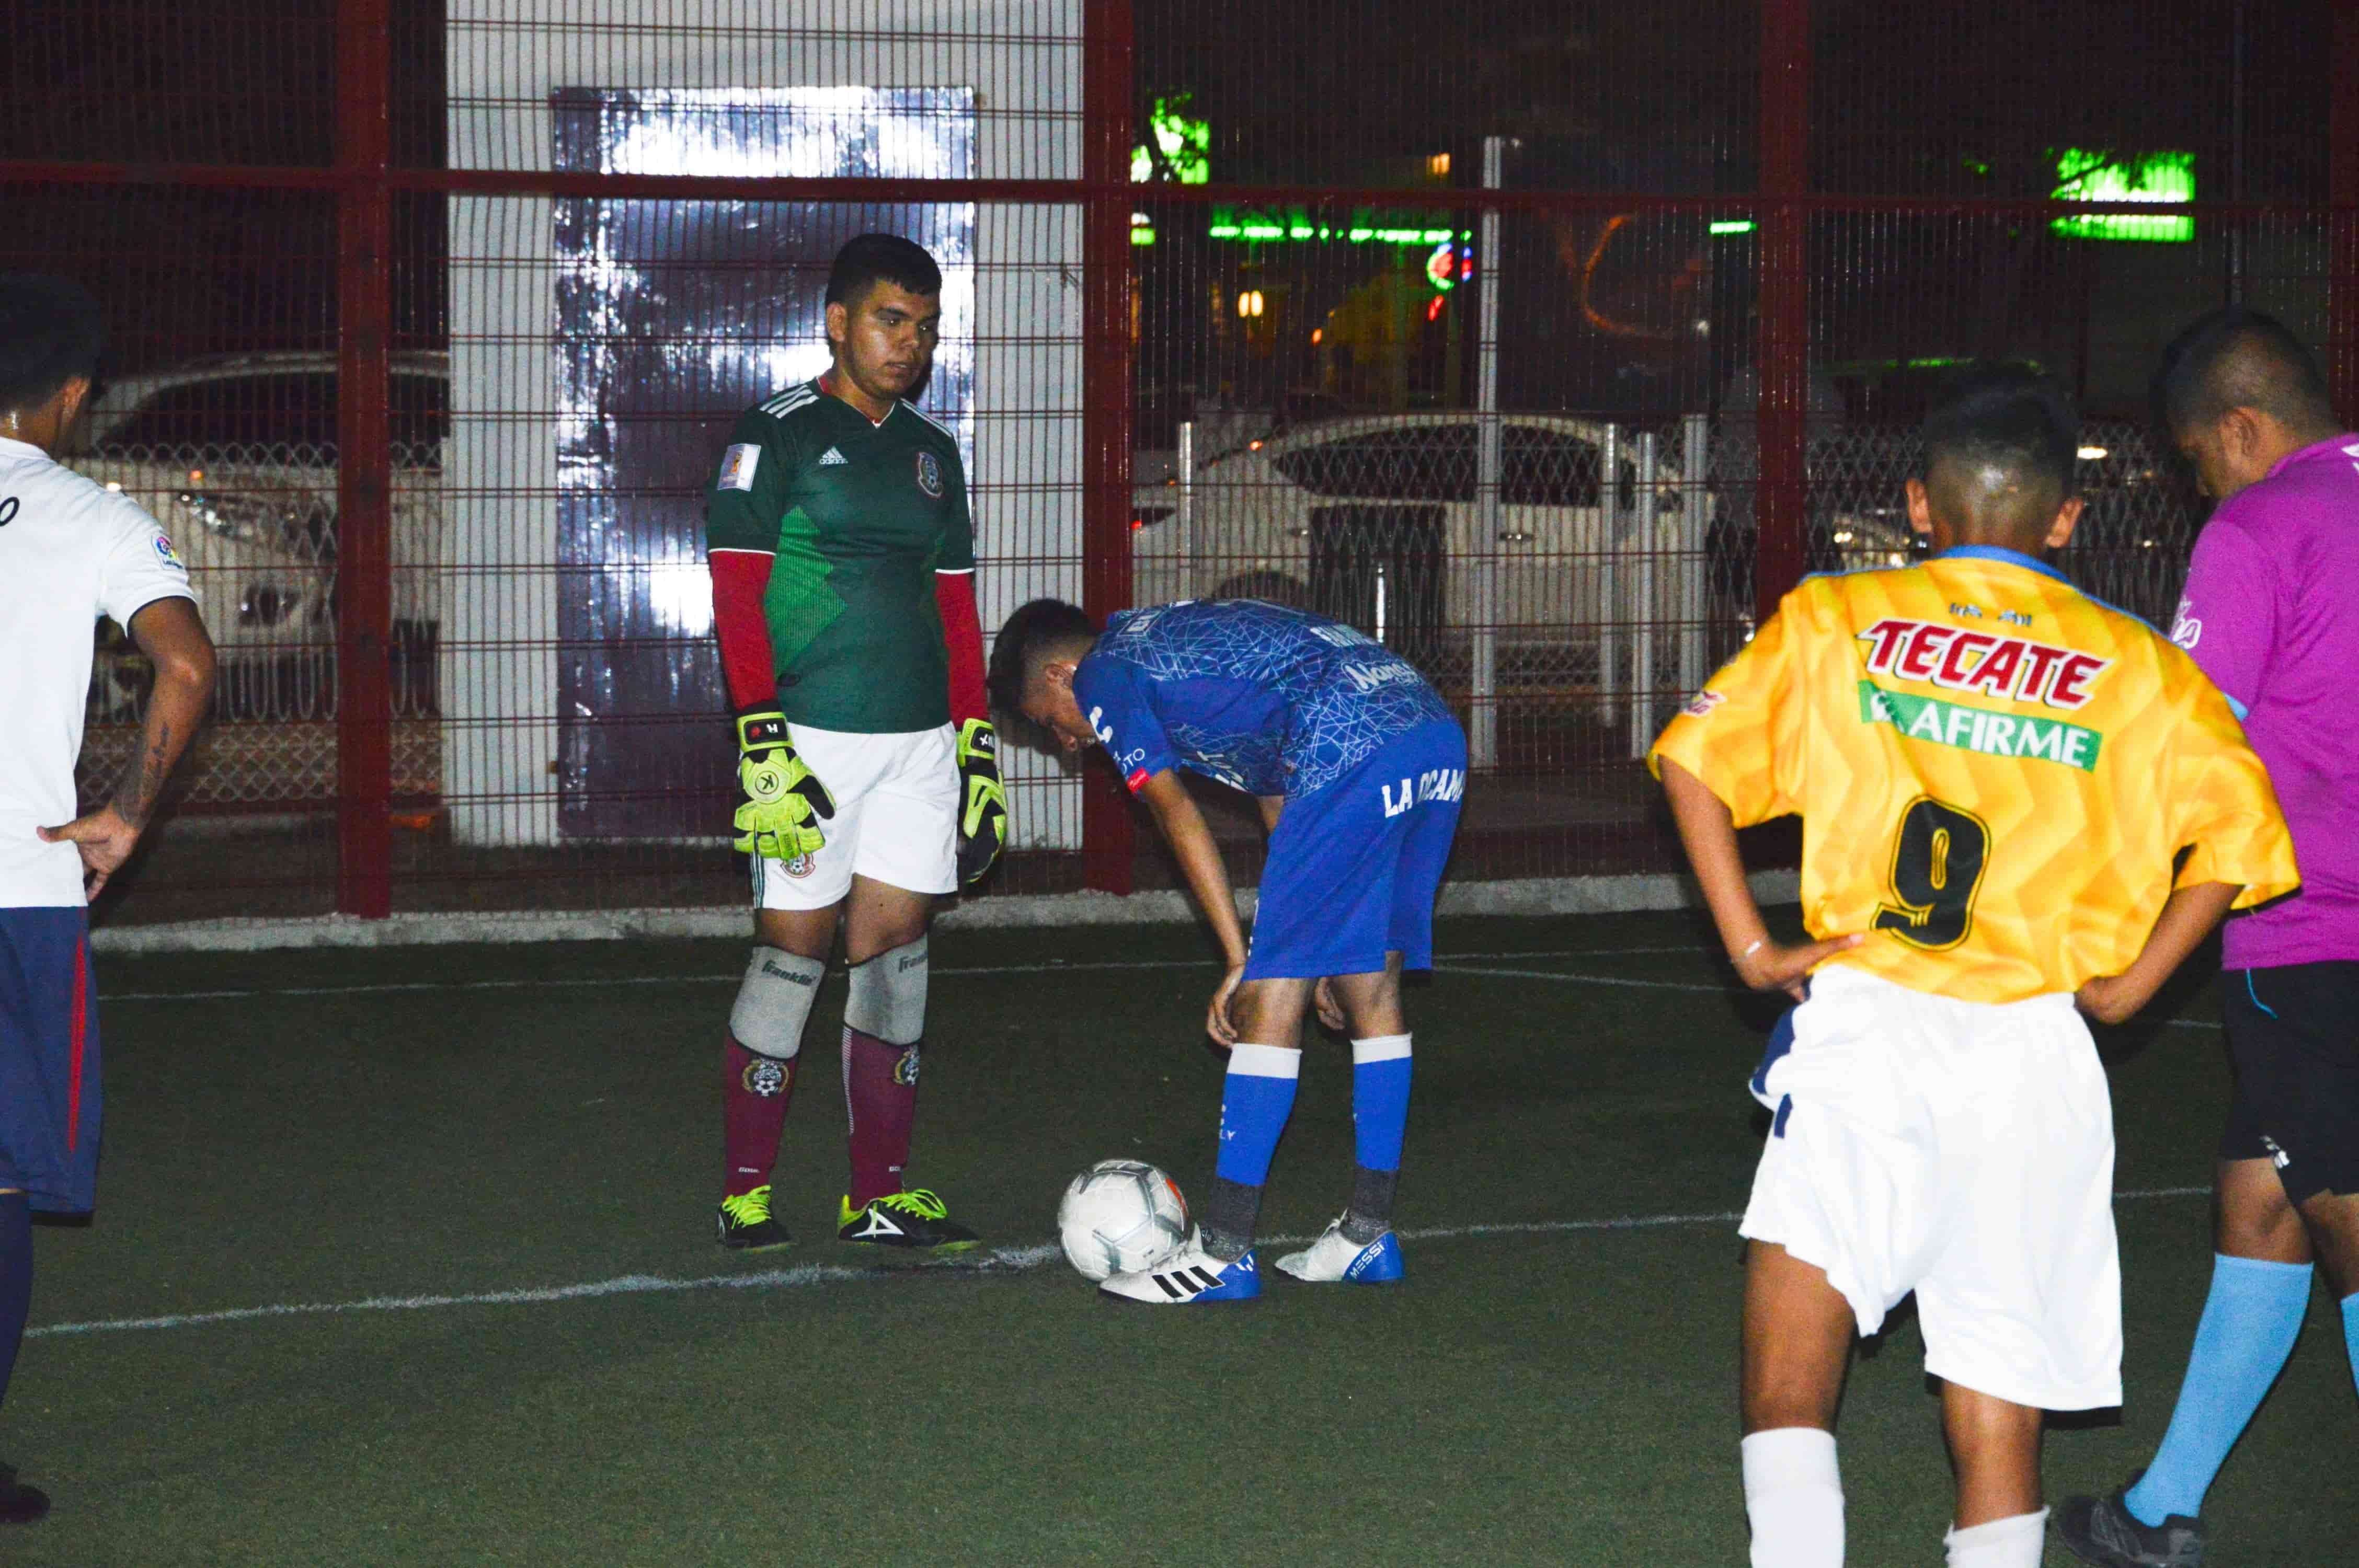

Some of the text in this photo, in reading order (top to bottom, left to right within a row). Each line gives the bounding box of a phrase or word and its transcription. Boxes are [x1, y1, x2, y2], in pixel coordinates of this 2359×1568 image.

[1858, 619, 2113, 709] TECATE
[1908, 701, 2090, 768] AFIRME
[1382, 778, 1413, 818] LA
[1870, 793, 1991, 952] 9
